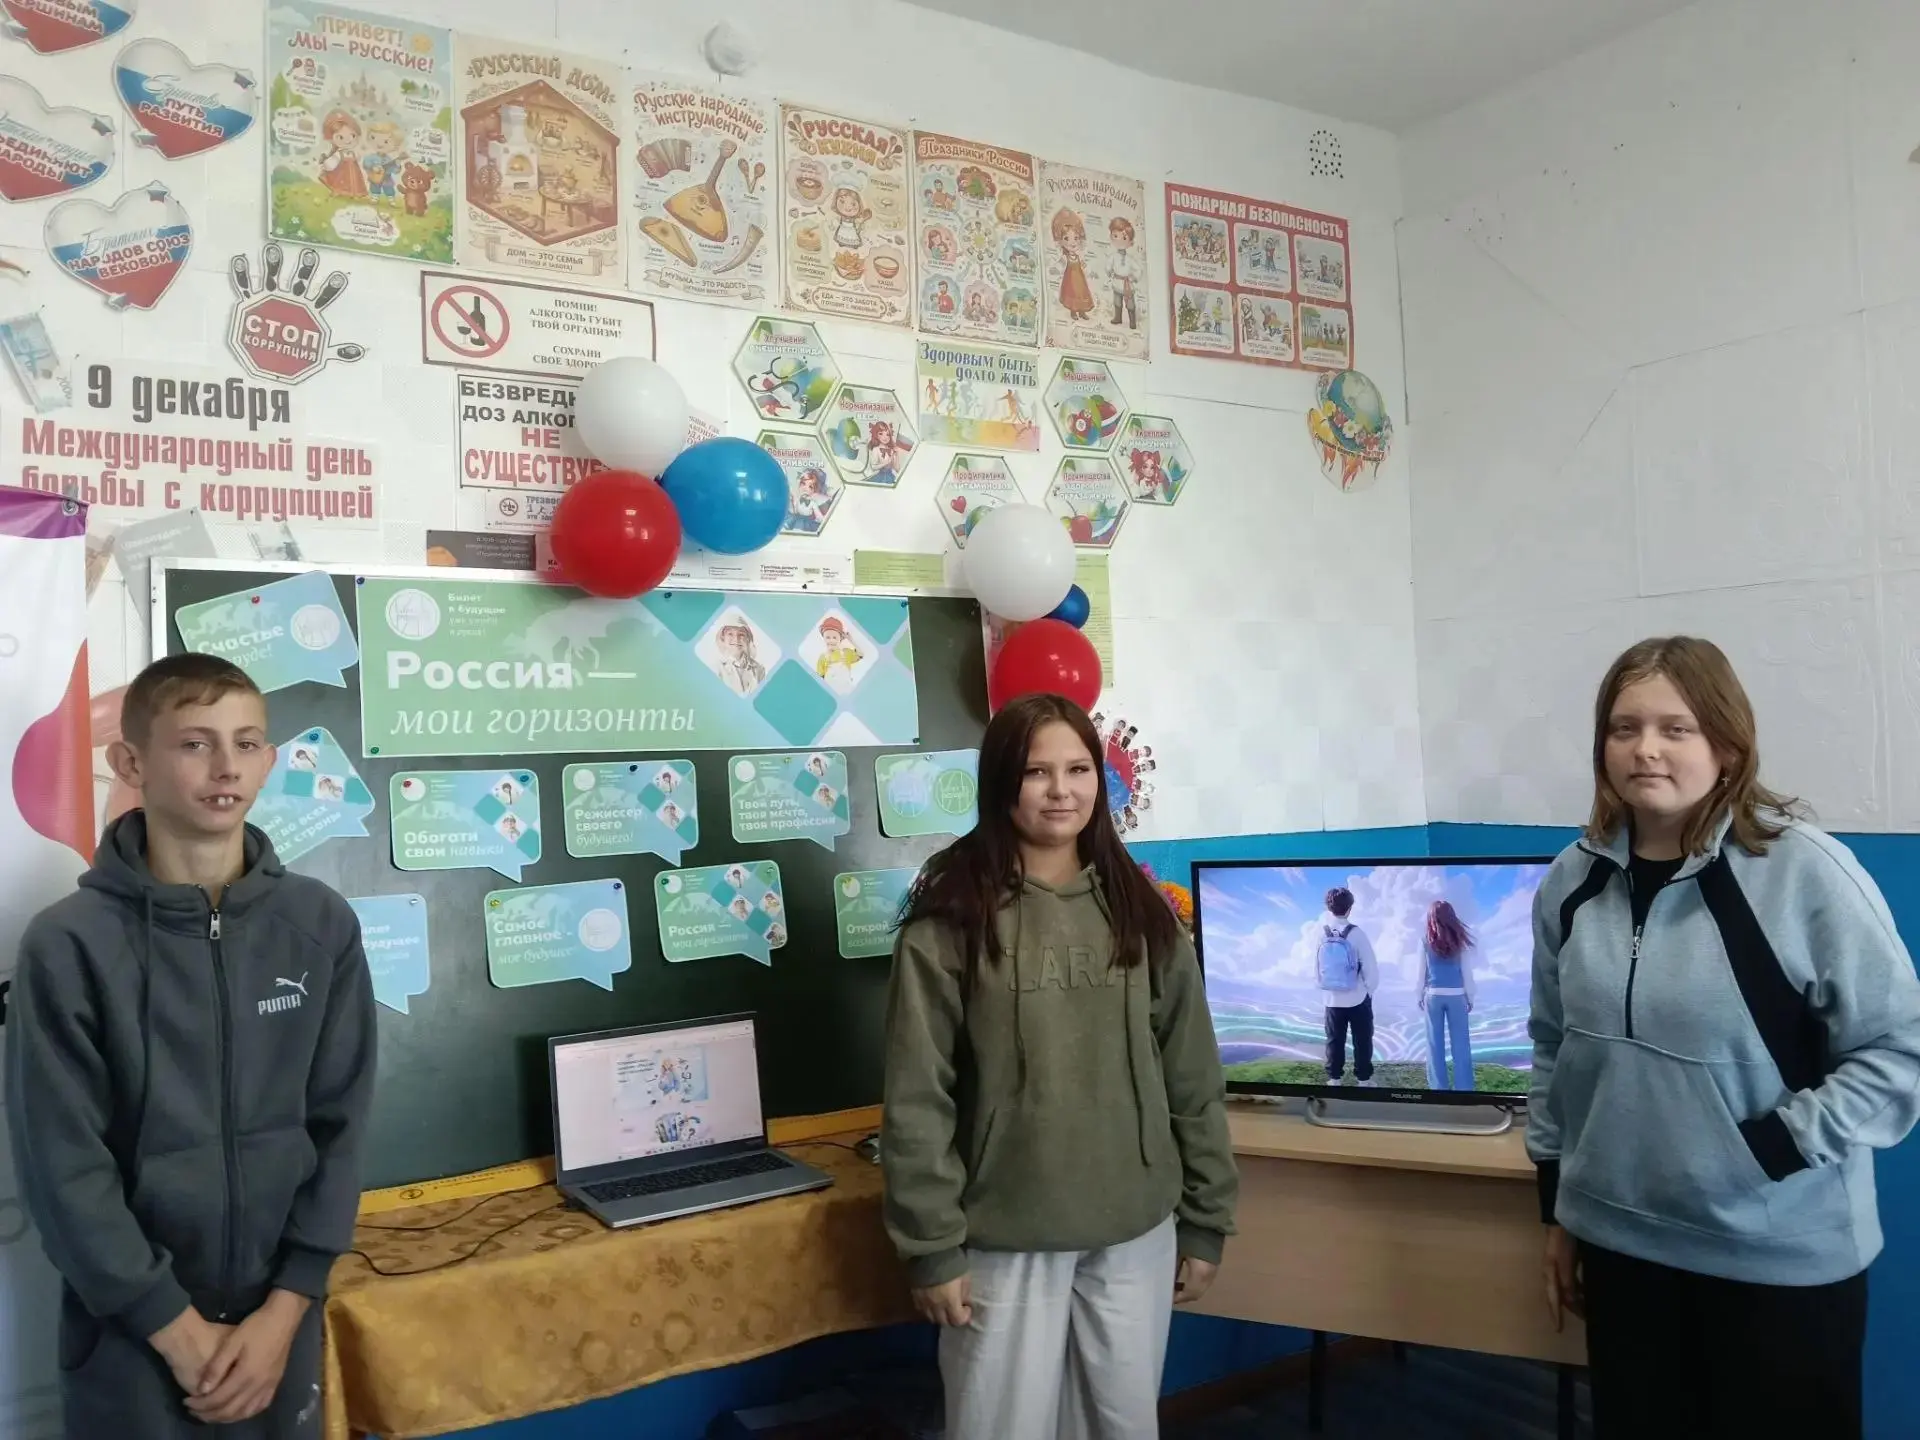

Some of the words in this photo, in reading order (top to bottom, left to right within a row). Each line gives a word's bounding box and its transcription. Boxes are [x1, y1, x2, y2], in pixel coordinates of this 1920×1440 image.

[471, 53, 562, 80] РУССКИЙ
[565, 67, 611, 104] ДОМ
[165, 98, 206, 119] ПУТЬ
[634, 92, 696, 113] Русские
[701, 95, 764, 134] народные
[139, 102, 224, 137] РАЗВИТИЯ
[655, 110, 749, 142] инструменты
[802, 119, 889, 155] РУССКАЯ
[0, 148, 63, 181] АРОДЫ
[1171, 190, 1248, 220] ПОЖАРНАЯ
[1249, 203, 1344, 240] БЕЗОПАСНОСТЬ
[146, 233, 191, 253] СОЮЗ
[99, 250, 172, 279] ВЕКОВОЙ
[507, 249, 527, 258] ДОМ
[538, 252, 554, 262] ЭТО
[556, 256, 583, 266] СЕМЬЯ
[553, 299, 598, 313] ПОМНИ!
[529, 308, 587, 323] АЛКОГОЛЬ
[588, 316, 623, 328] ГУБИТ
[244, 314, 320, 349] СТОП
[532, 319, 561, 332] ТВОЙ
[562, 324, 622, 340] ОРГАНИЗМ!
[243, 334, 317, 362] КОРРУПЦИЯ
[553, 345, 601, 359] СОХРАНИ
[921, 342, 994, 368] Здоровым
[533, 354, 562, 366] СВОЕ
[564, 358, 602, 370] ЗДОРО
[955, 367, 996, 382] долго
[1000, 372, 1037, 387] жить
[88, 364, 112, 409] 9
[132, 376, 291, 431] декабря
[839, 401, 896, 412] Нормализация
[462, 405, 506, 423] ДОЗ
[521, 426, 561, 450] НЕ
[22, 418, 294, 477] Международный
[306, 444, 373, 482] день
[767, 447, 812, 458] Повышение
[164, 481, 182, 510] с
[200, 484, 374, 522] коррупцией
[448, 593, 482, 602] Билет
[197, 625, 284, 655] Счастье
[229, 644, 273, 668] руде!
[386, 650, 575, 690] Россия
[390, 709, 475, 736] мои
[486, 705, 696, 742] горизонты
[739, 799, 768, 809] Твой
[574, 808, 643, 821] Режиссер
[739, 812, 767, 820] твоя
[739, 822, 768, 831] твоя
[770, 817, 837, 830] профессия
[575, 820, 623, 832] своего
[403, 830, 479, 845] Обогати
[404, 847, 446, 859] свои
[493, 920, 545, 934] Самое
[668, 923, 716, 938] Россия
[845, 920, 890, 935] Открой
[494, 930, 563, 948] главное
[257, 993, 302, 1016] PUMA
